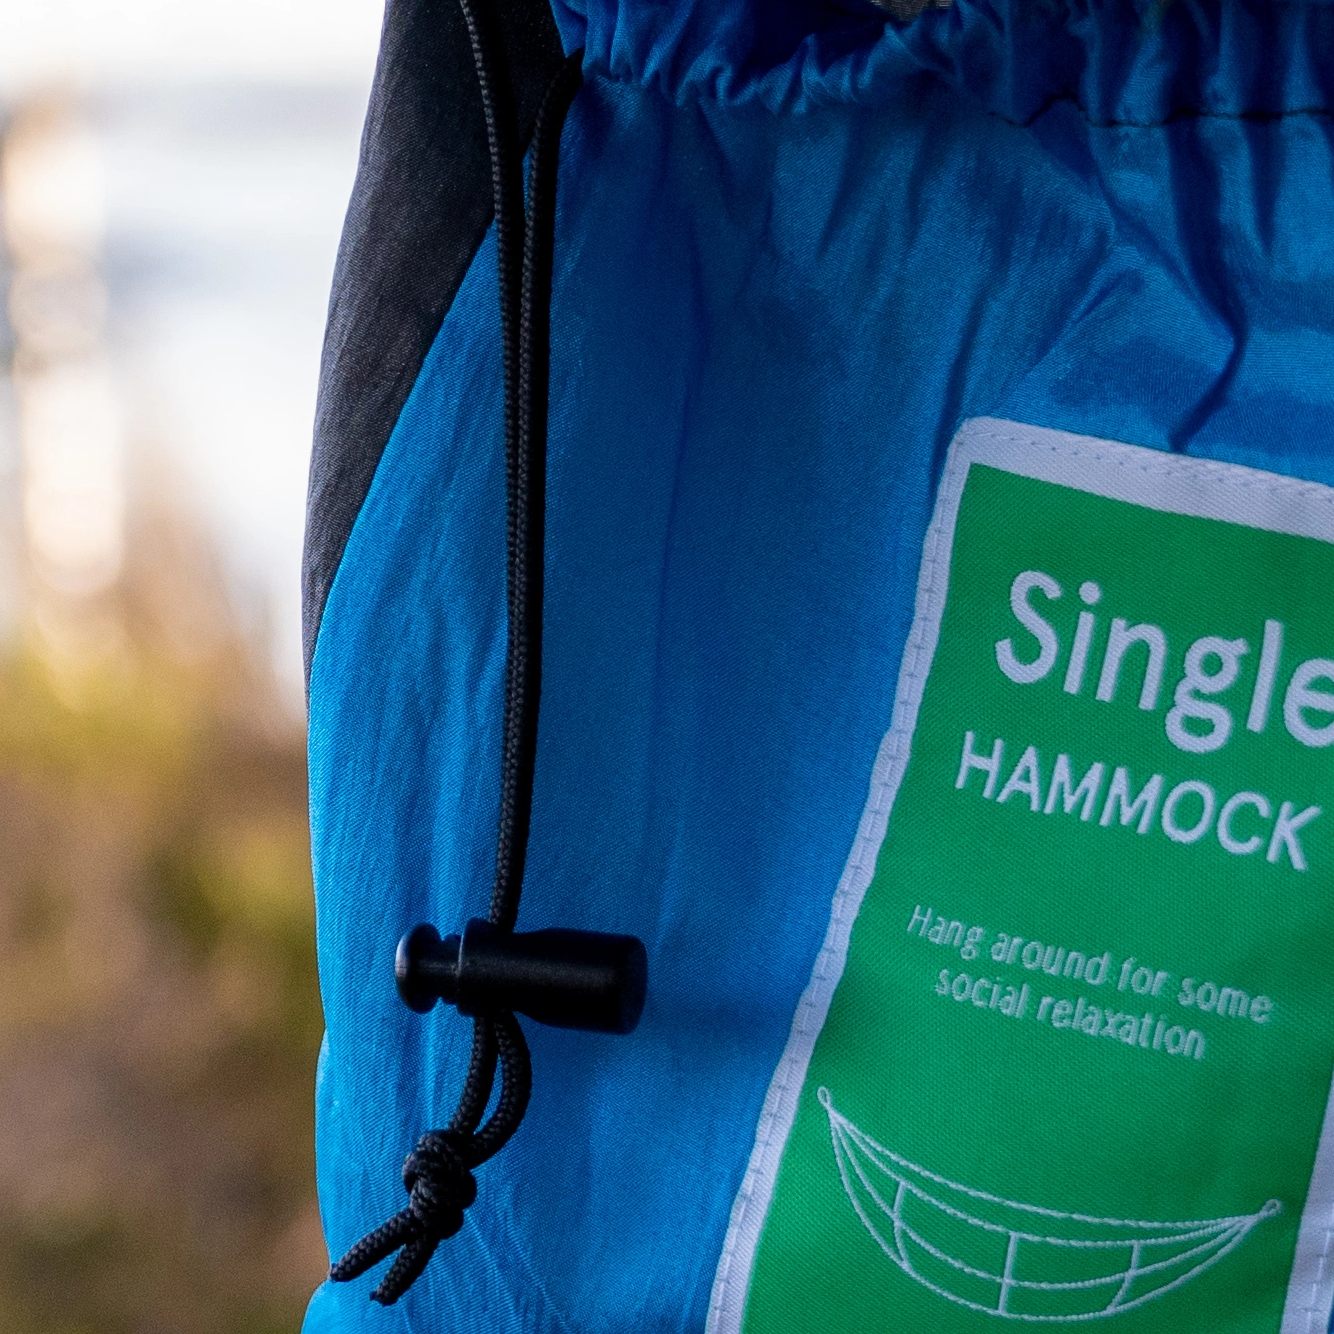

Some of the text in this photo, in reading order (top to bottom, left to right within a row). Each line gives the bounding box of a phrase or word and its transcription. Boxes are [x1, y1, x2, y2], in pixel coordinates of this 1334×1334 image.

[955, 731, 1322, 871] HAMMOCK
[906, 904, 1275, 1024] Hang around for some
[934, 968, 1206, 1061] social relaxation
